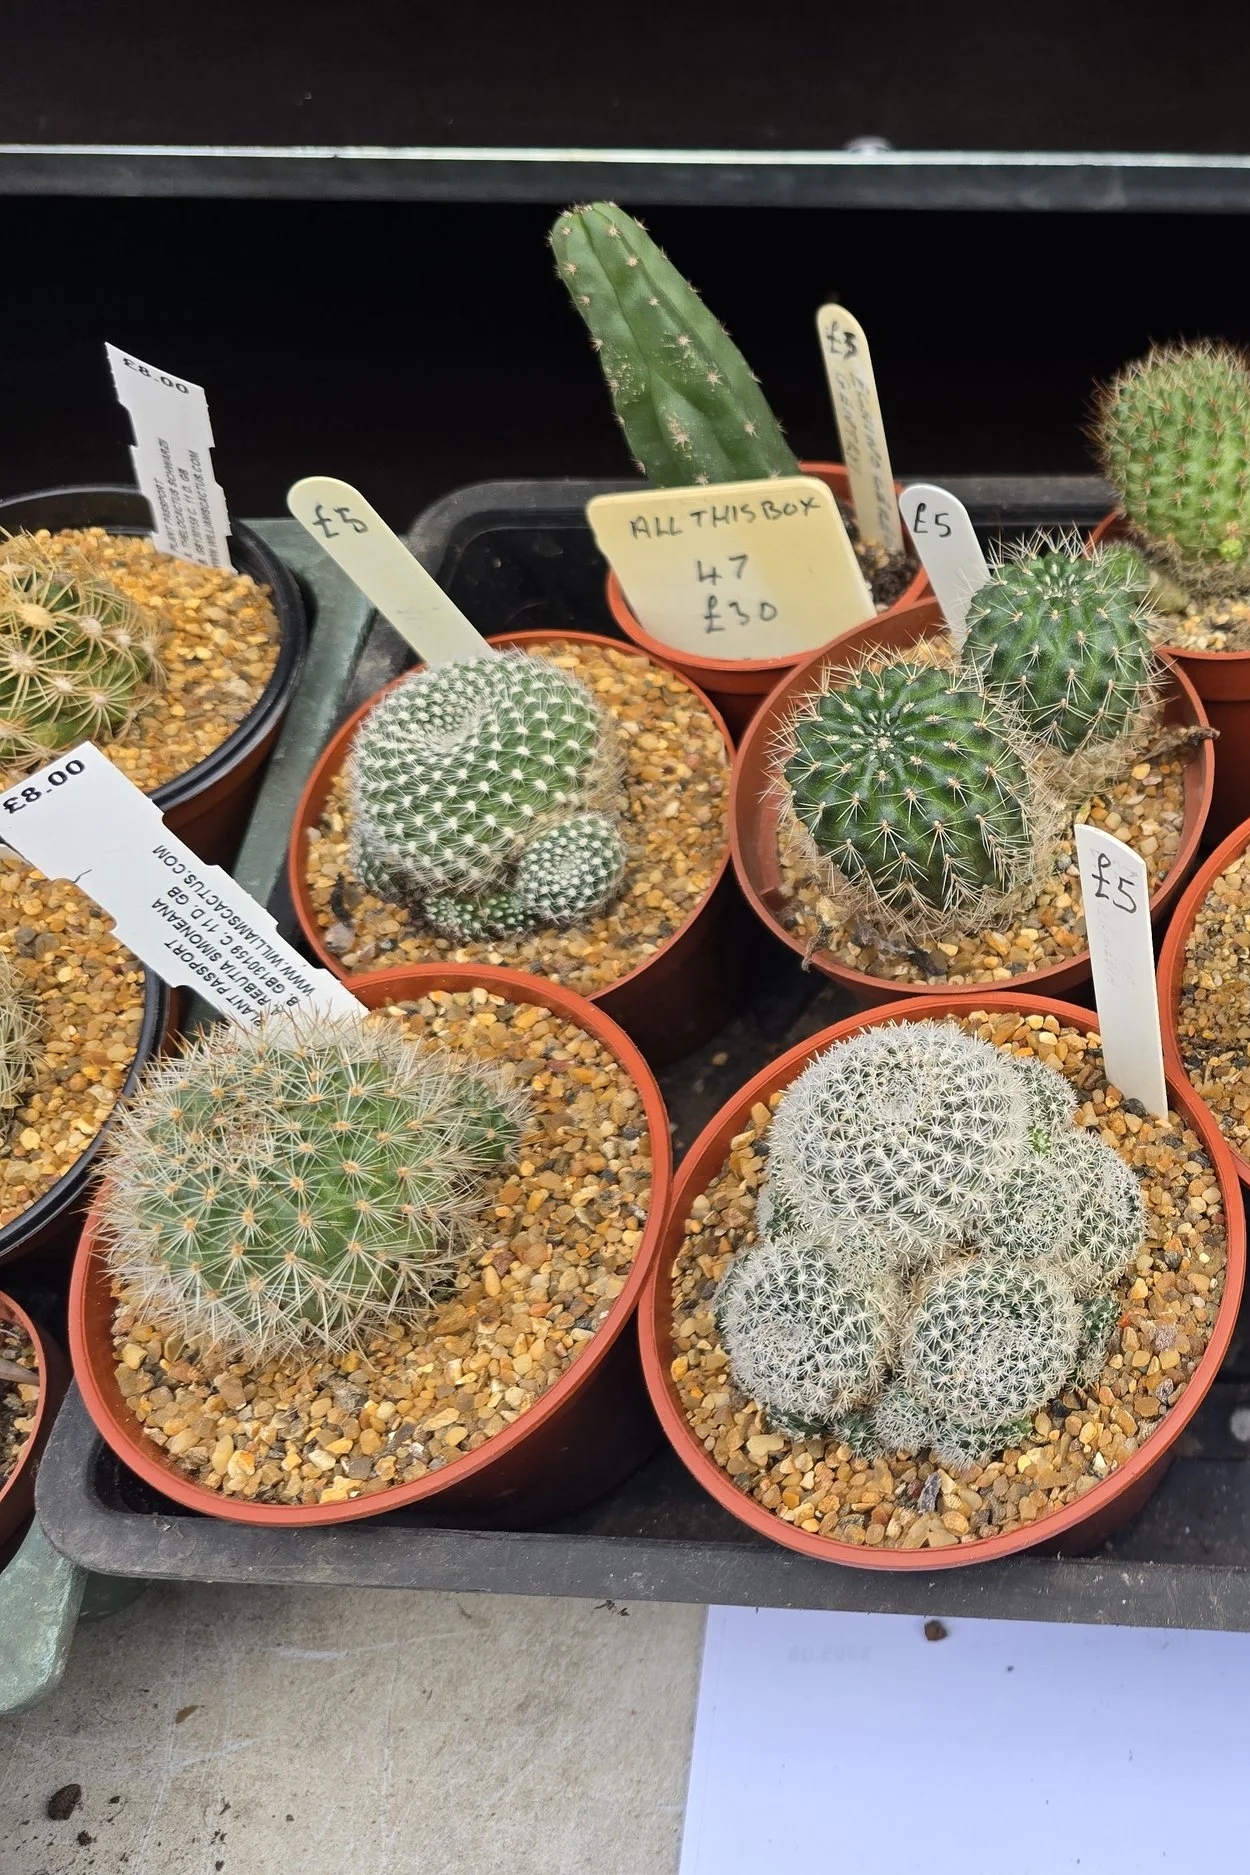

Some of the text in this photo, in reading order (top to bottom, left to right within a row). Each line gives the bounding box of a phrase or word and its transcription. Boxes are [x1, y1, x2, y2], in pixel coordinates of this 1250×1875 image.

[122, 357, 189, 395] £8.00
[312, 504, 369, 540] £5
[630, 497, 821, 539] ALL THIS BOX
[914, 502, 952, 538] £5
[704, 595, 778, 633] £30
[2, 759, 87, 815] £8.00
[1092, 853, 1137, 913] £5
[151, 898, 222, 962] SIMONEANA
[152, 844, 316, 997] WWW.WILLIAMSCACTUS.COM
[167, 886, 299, 1007] B. GB130159 C. 11 D. GB
[163, 939, 263, 1028] PLANT PASSPORT
[219, 960, 271, 1006] REBUTIA
